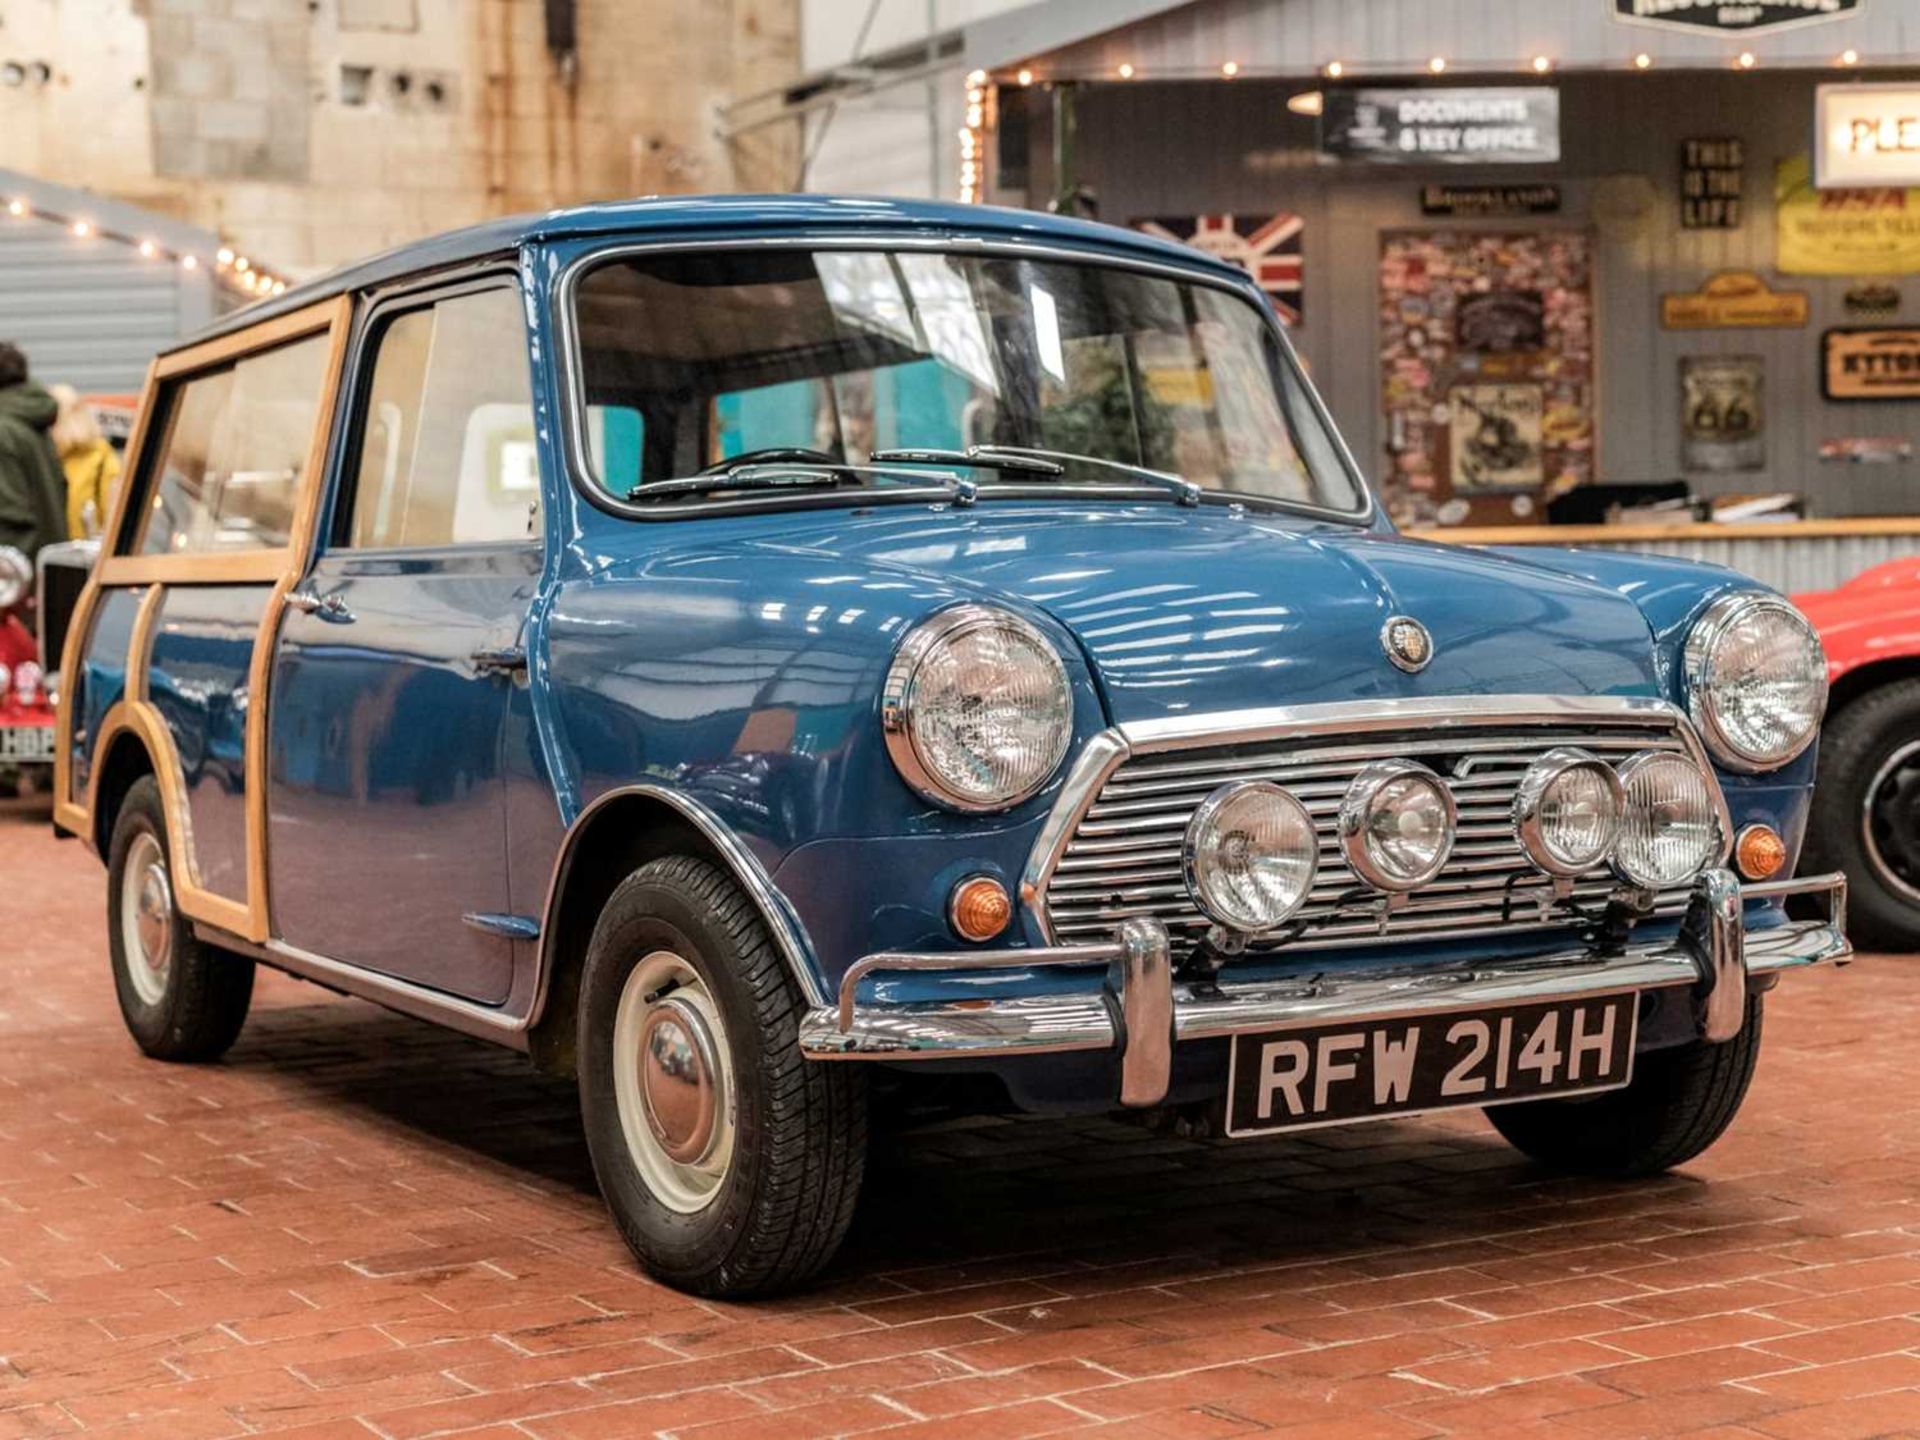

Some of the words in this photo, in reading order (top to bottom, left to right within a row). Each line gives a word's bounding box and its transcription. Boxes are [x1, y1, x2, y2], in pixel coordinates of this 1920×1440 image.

[1398, 99, 1529, 123] DOCUMENTS
[1399, 127, 1417, 151] &
[1419, 127, 1461, 151] KEY
[1463, 126, 1537, 149] OFFICE
[1257, 1027, 1420, 1119] RFW
[1441, 1005, 1616, 1096] 214H
